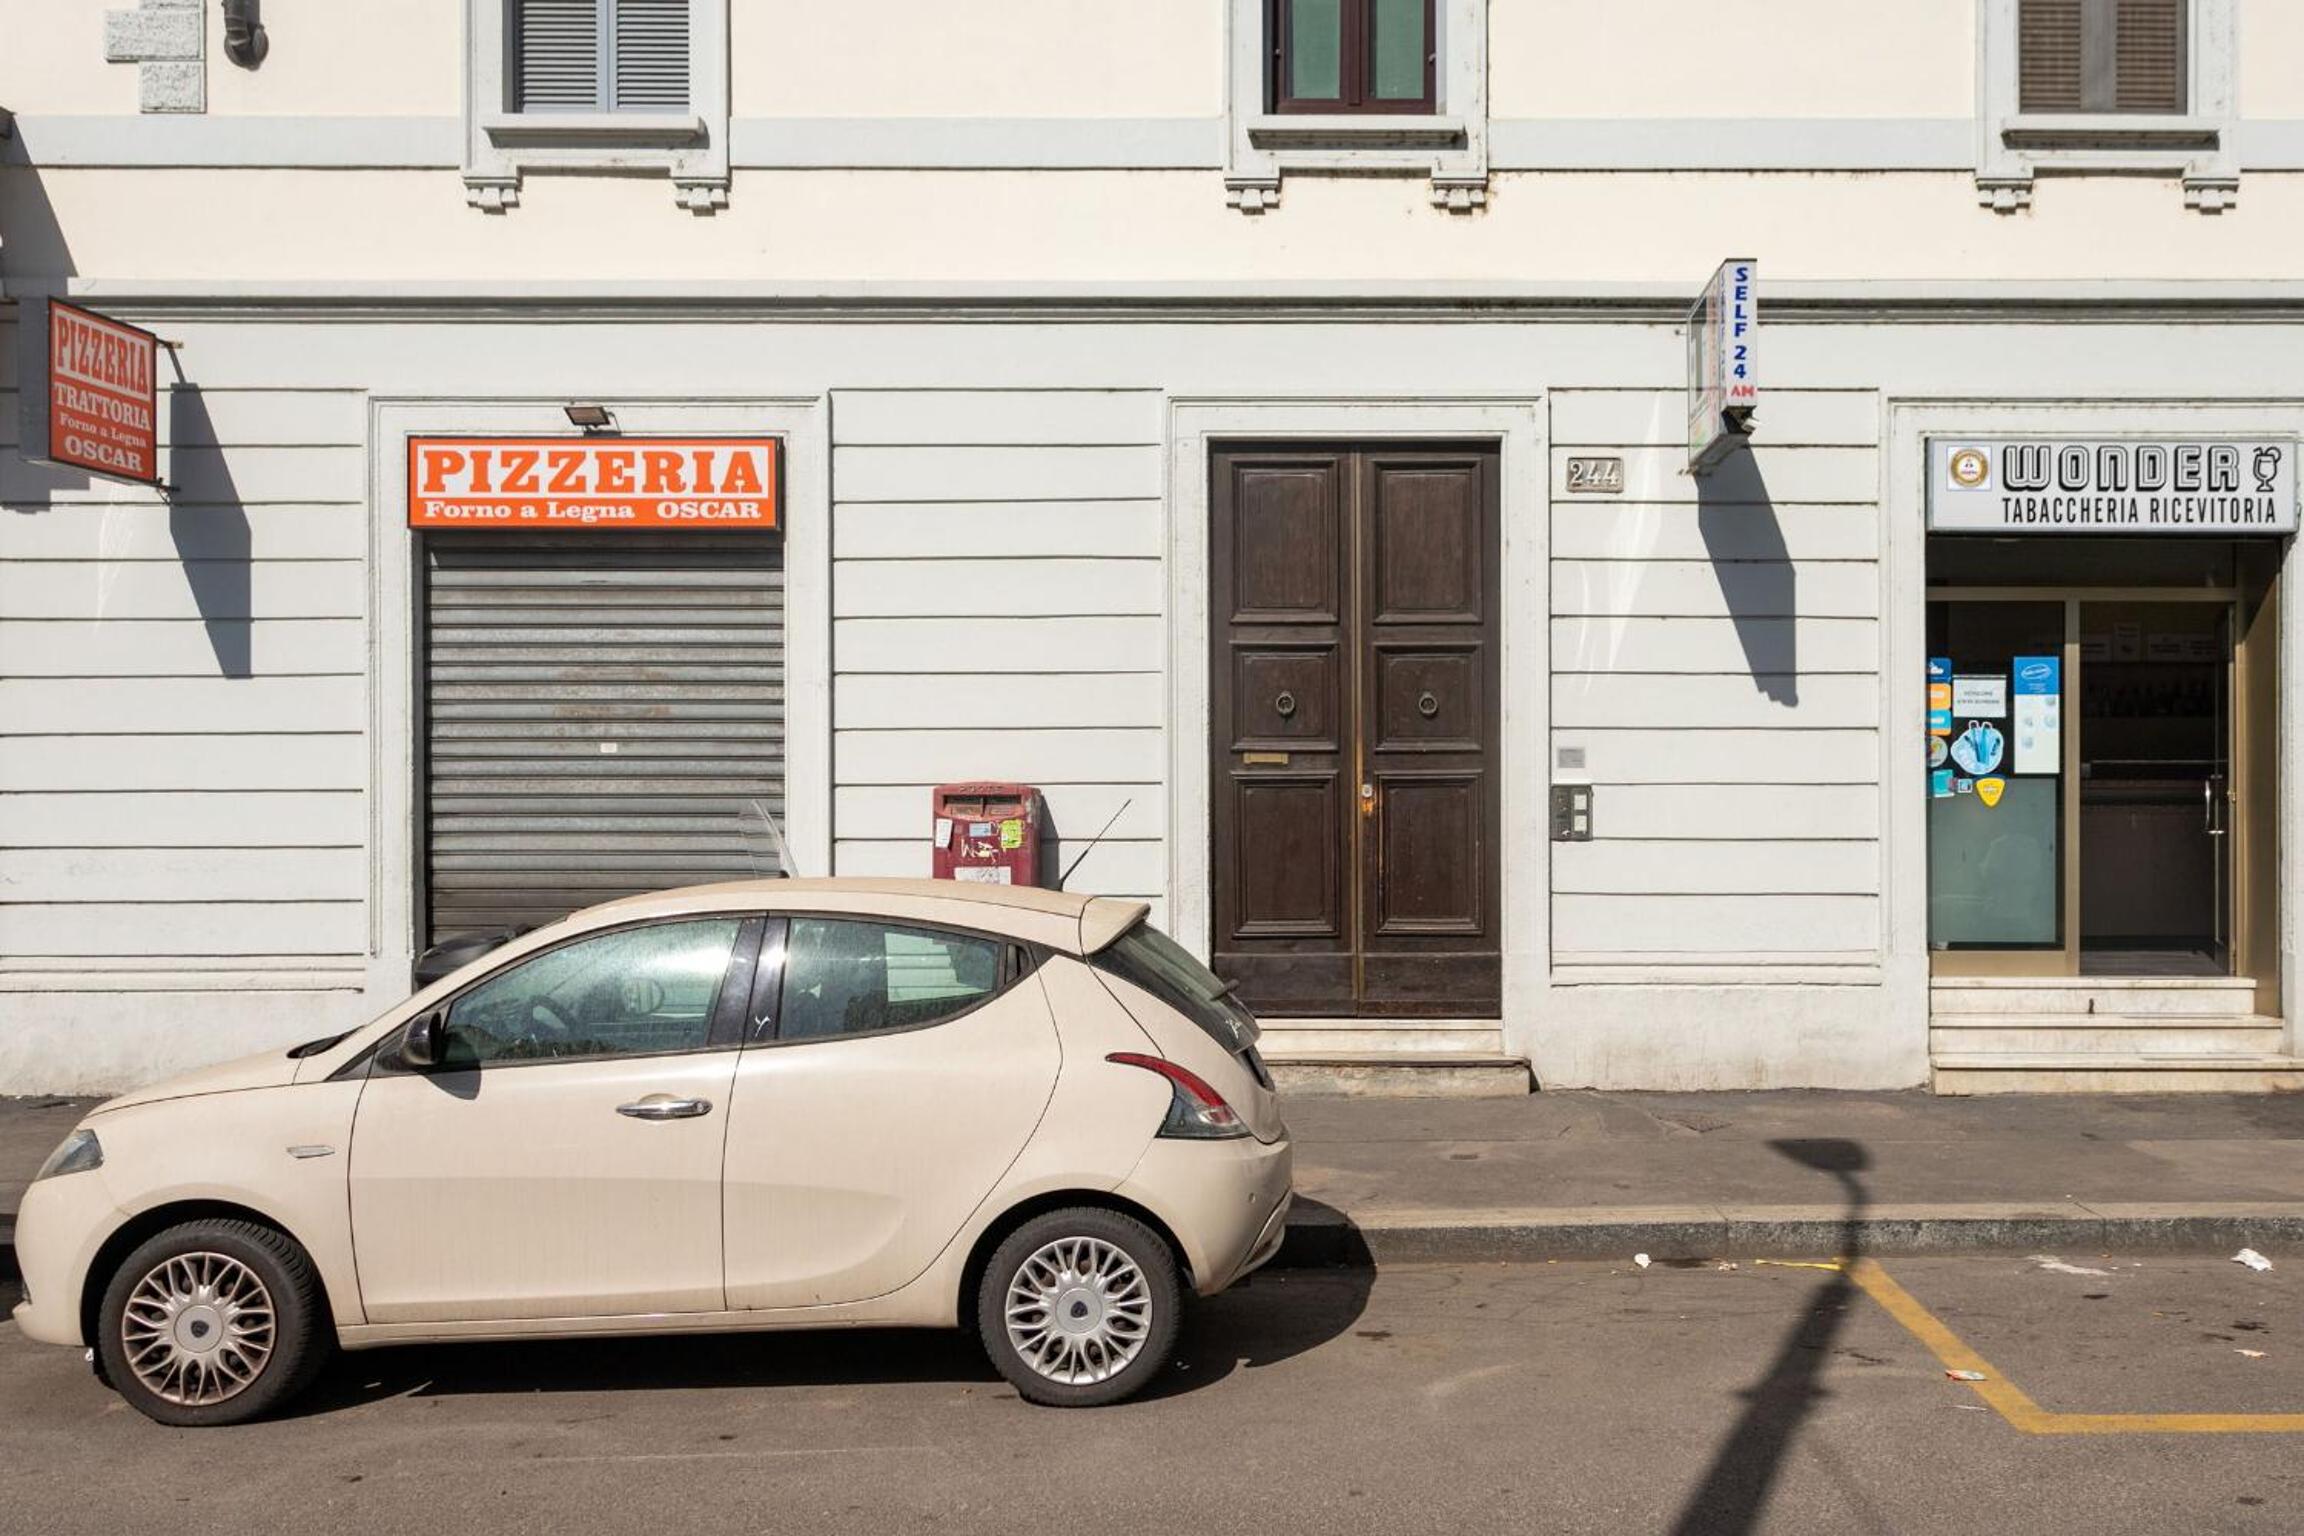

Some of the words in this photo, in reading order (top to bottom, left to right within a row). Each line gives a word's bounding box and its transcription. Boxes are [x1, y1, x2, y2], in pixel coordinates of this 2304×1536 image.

[1734, 266, 1748, 338] SELF
[57, 317, 148, 395] PIZZERIA
[1733, 345, 1747, 379] 24
[54, 382, 151, 431] TRATTORIA
[60, 412, 97, 434] Forno
[100, 427, 110, 438] a
[111, 426, 147, 448] Legna
[65, 436, 143, 471] OSCAR
[2002, 445, 2240, 492] WONDER
[423, 450, 763, 493] PIZZERIA
[1570, 461, 1619, 486] 244
[424, 501, 511, 519] Forno
[520, 505, 538, 519] a
[547, 501, 635, 523] Legna
[656, 501, 762, 519] OSCAR
[2002, 497, 2139, 523] TABACCHERIA
[2149, 497, 2276, 523] RICEVITORIA
